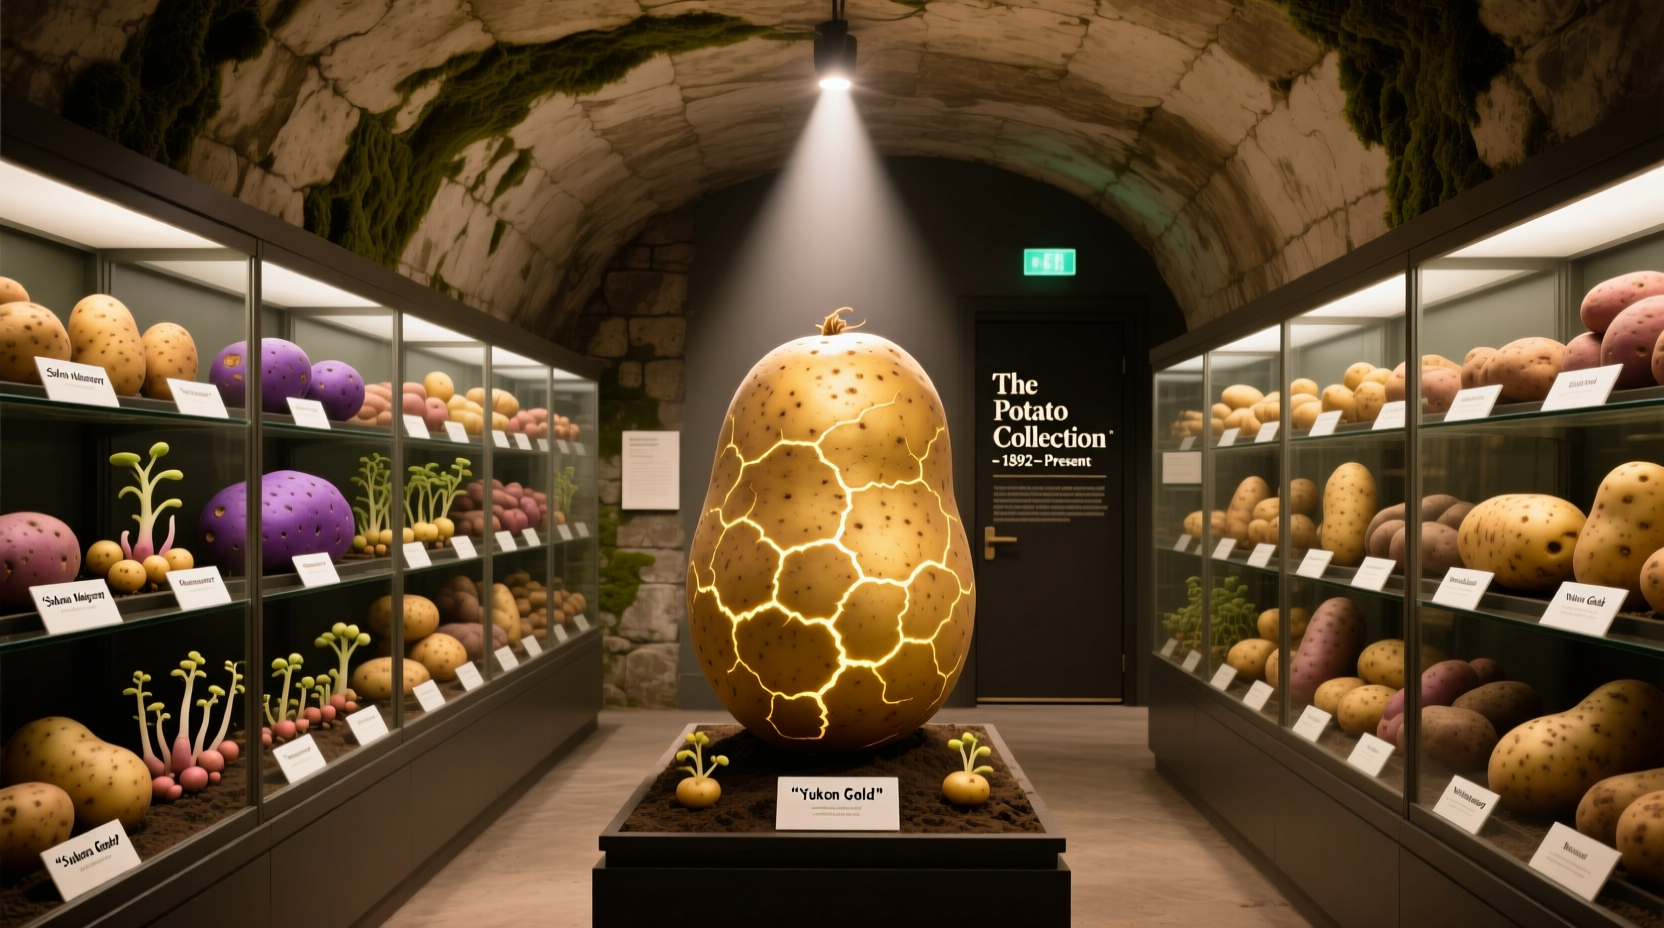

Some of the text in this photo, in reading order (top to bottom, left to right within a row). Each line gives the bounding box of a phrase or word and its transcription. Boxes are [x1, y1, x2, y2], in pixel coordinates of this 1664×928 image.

[992, 372, 1039, 395] The
[993, 400, 1068, 422] Potato
[993, 425, 1107, 448] Collection
